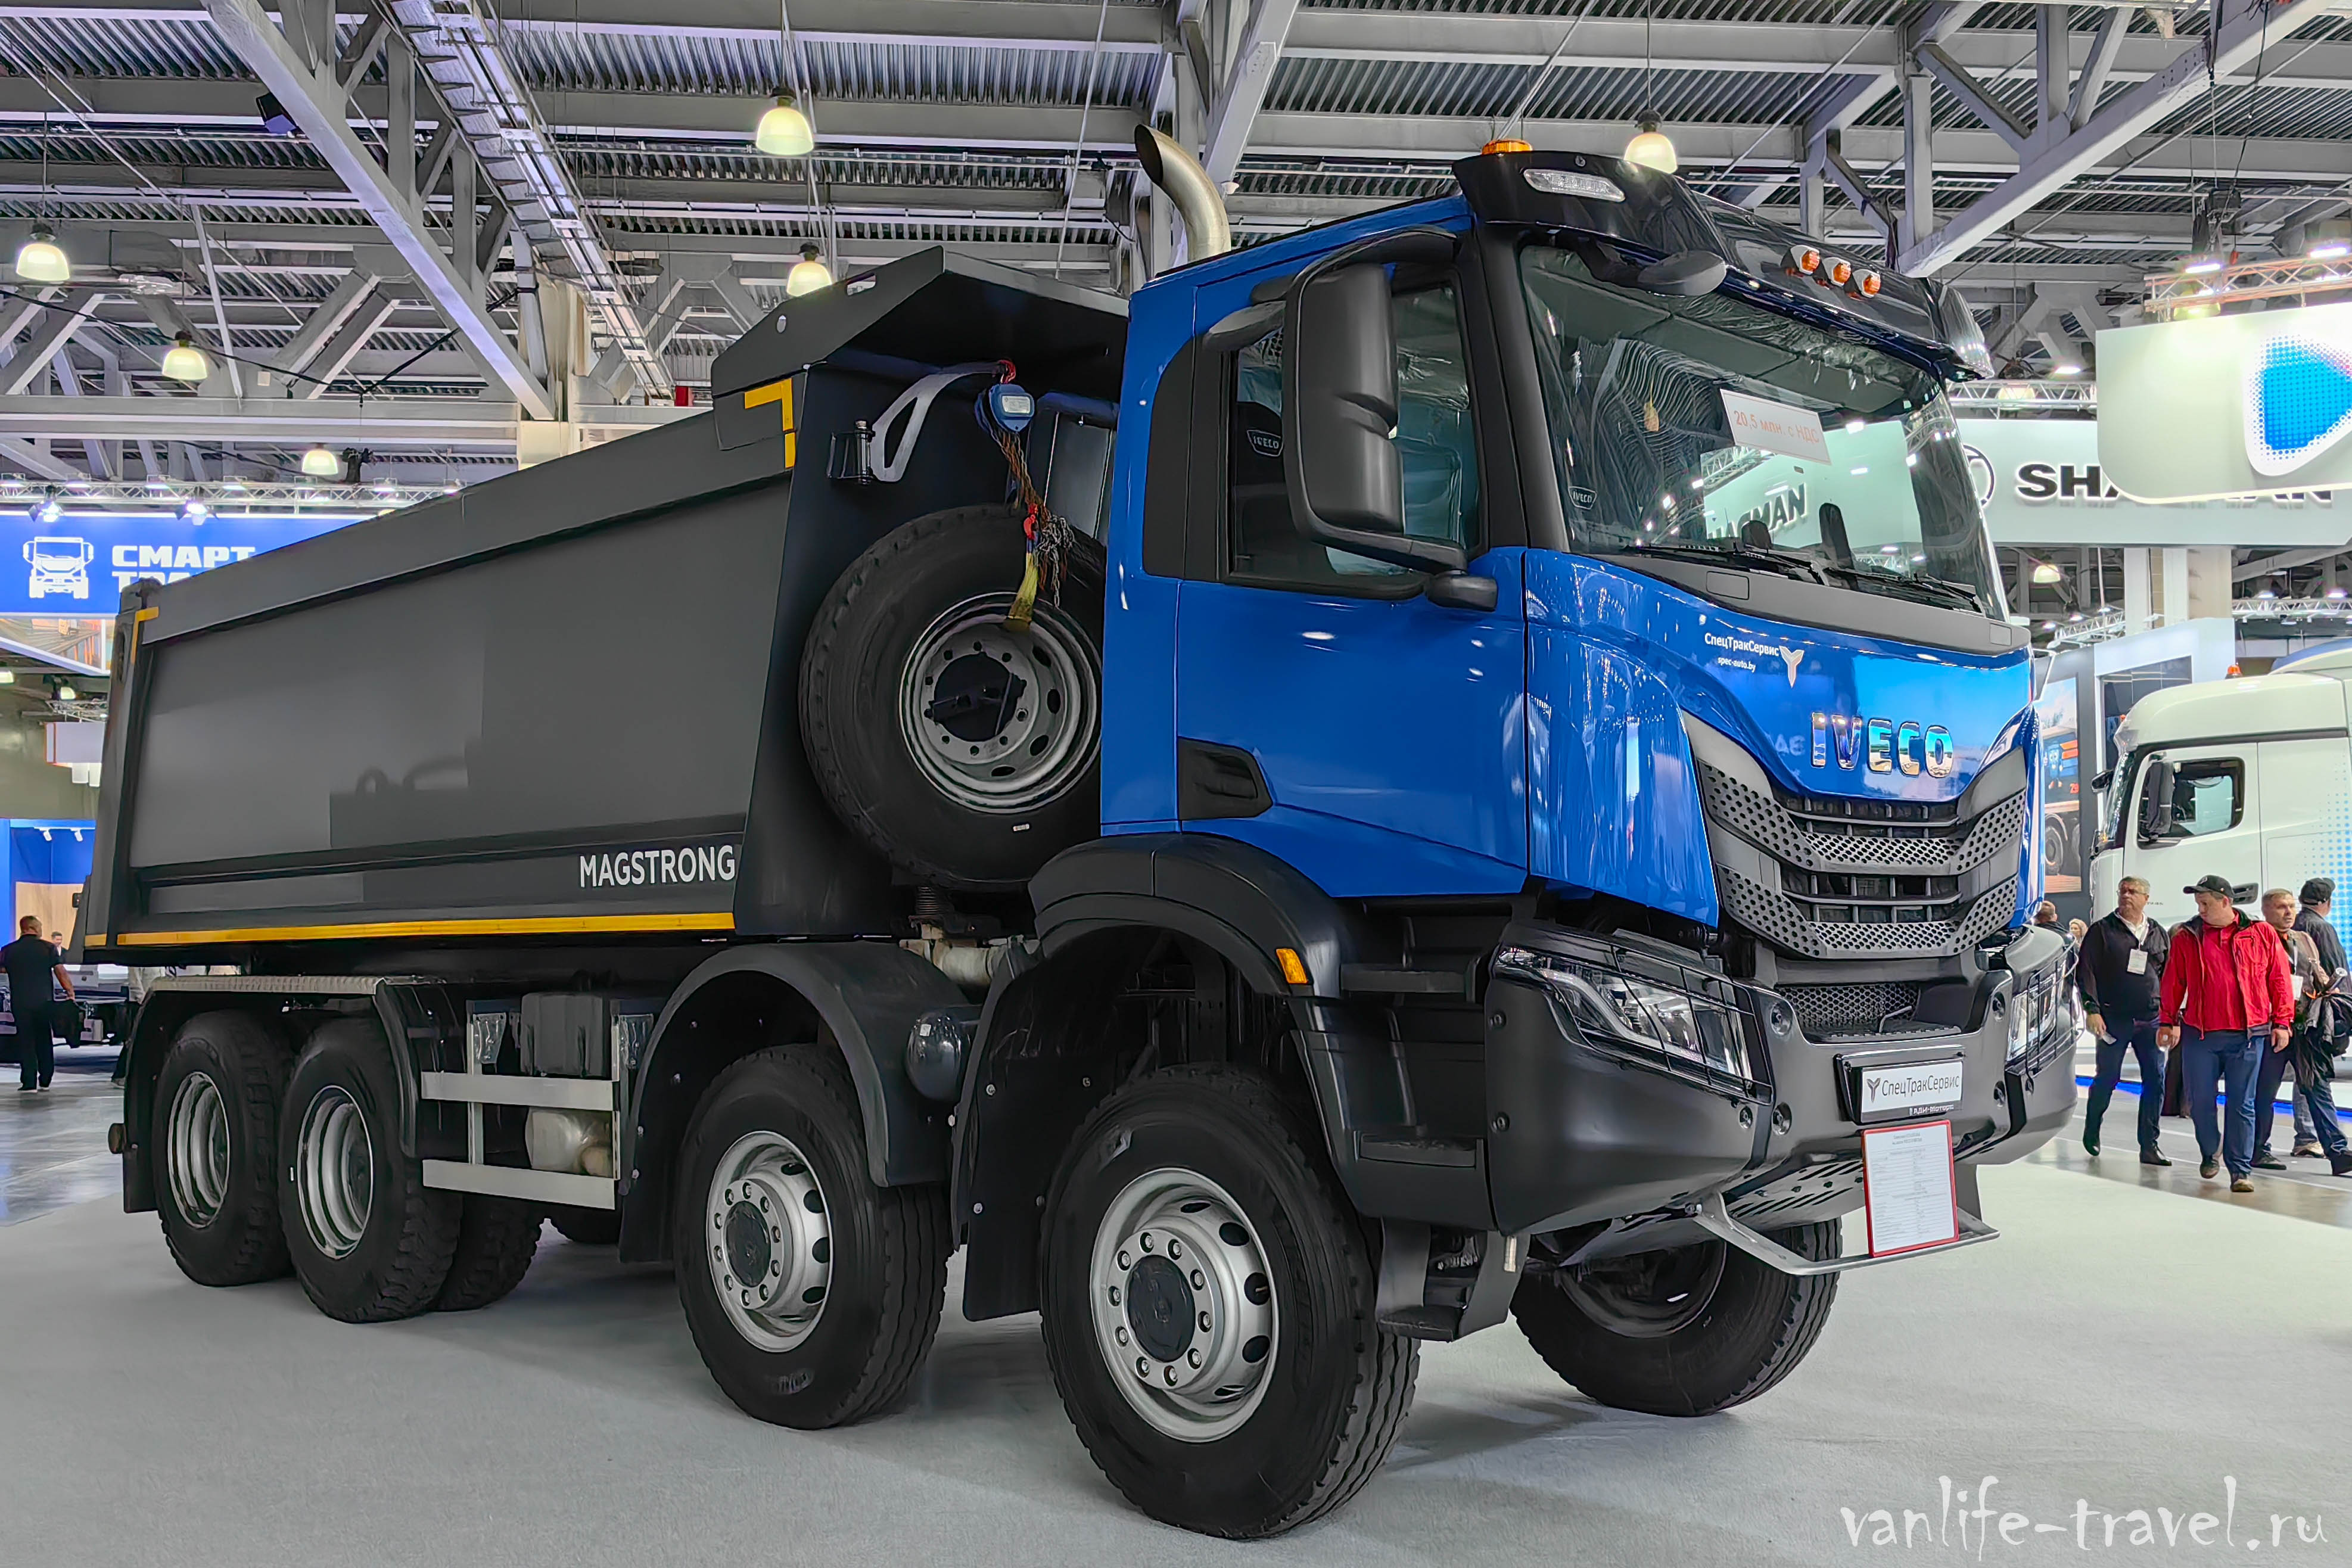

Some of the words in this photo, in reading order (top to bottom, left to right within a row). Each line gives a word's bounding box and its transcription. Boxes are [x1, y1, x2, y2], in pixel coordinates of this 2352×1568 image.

[1734, 409, 1757, 430] 20,5
[1796, 424, 1819, 444] НДС
[1573, 490, 1592, 503] IVECO
[1704, 633, 1779, 657] СпецТракСервис
[1718, 657, 1756, 673] spec-auto.by
[1810, 711, 1955, 779] IVECO
[580, 845, 736, 888] MAGSTRONG
[1881, 1074, 1960, 1097] СпецТракСервис
